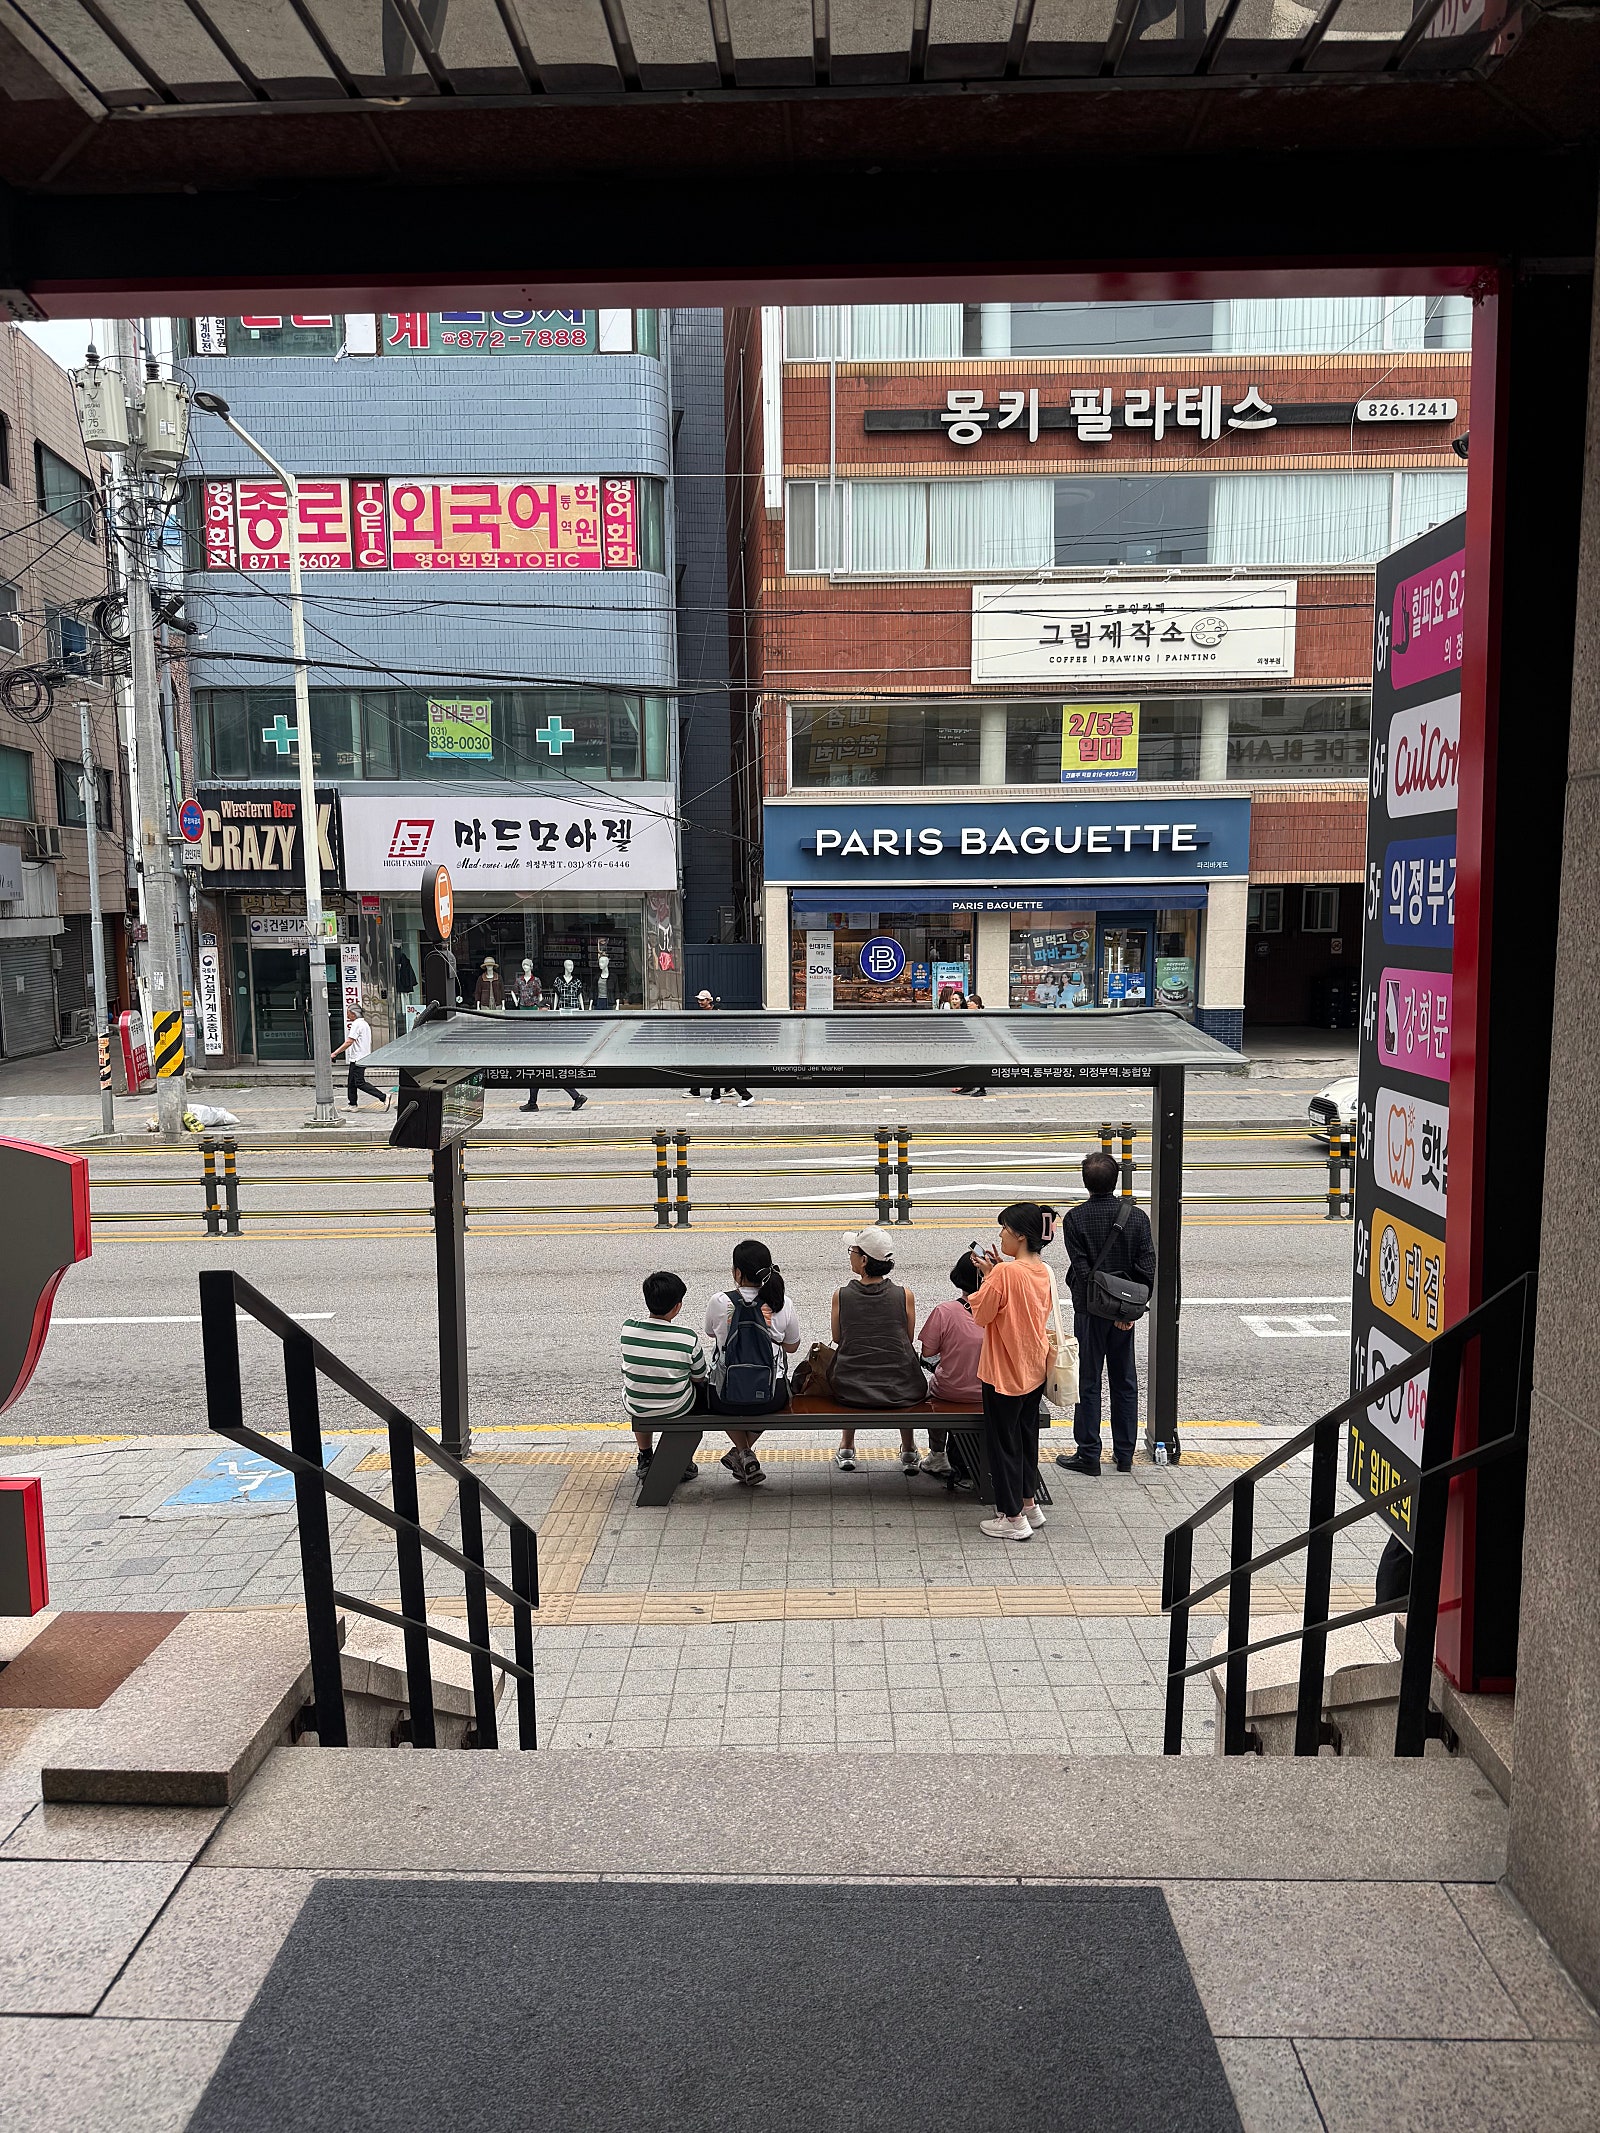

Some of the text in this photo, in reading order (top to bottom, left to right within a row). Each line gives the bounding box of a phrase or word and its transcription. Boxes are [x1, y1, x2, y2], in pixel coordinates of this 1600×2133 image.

[457, 329, 587, 347] 872-7888
[940, 386, 1279, 444] 몽키 필라테스
[1368, 401, 1449, 419] 826.1241
[208, 482, 237, 567] 영어회화
[240, 484, 347, 550] 종로
[356, 483, 386, 566] TOEIC
[392, 484, 559, 550] 외국어
[574, 483, 598, 548] 학원
[605, 479, 637, 567] 영어회화
[249, 554, 341, 569] 871-6602
[1038, 620, 1186, 650] 그림제작소
[1412, 578, 1444, 638] 힐피요
[1049, 653, 1217, 664] COFFEE DRAWING PAINTING
[1376, 610, 1390, 672] 8F
[429, 703, 489, 724] 임대문의
[430, 727, 448, 737] 031)
[1069, 711, 1133, 737] 2/5층
[430, 736, 491, 750] 838-0030
[1079, 737, 1122, 761] 임대
[1372, 737, 1386, 799] 6F
[221, 800, 296, 818] Western Bar
[454, 819, 632, 853] 마드모아젤
[202, 809, 297, 871] CRAZY
[383, 859, 433, 867] HIGH FASHION
[816, 823, 1198, 856] PARIS BAGUETTE
[952, 901, 1043, 910] PARIS BAGUETTE
[1367, 862, 1382, 921] 5F
[809, 965, 832, 975] 50%
[1363, 983, 1377, 1042] 4F
[1402, 987, 1449, 1059] 강희문
[1359, 1102, 1373, 1161] 3F
[1355, 1218, 1369, 1278] 2F
[1351, 1425, 1365, 1487] 7F
